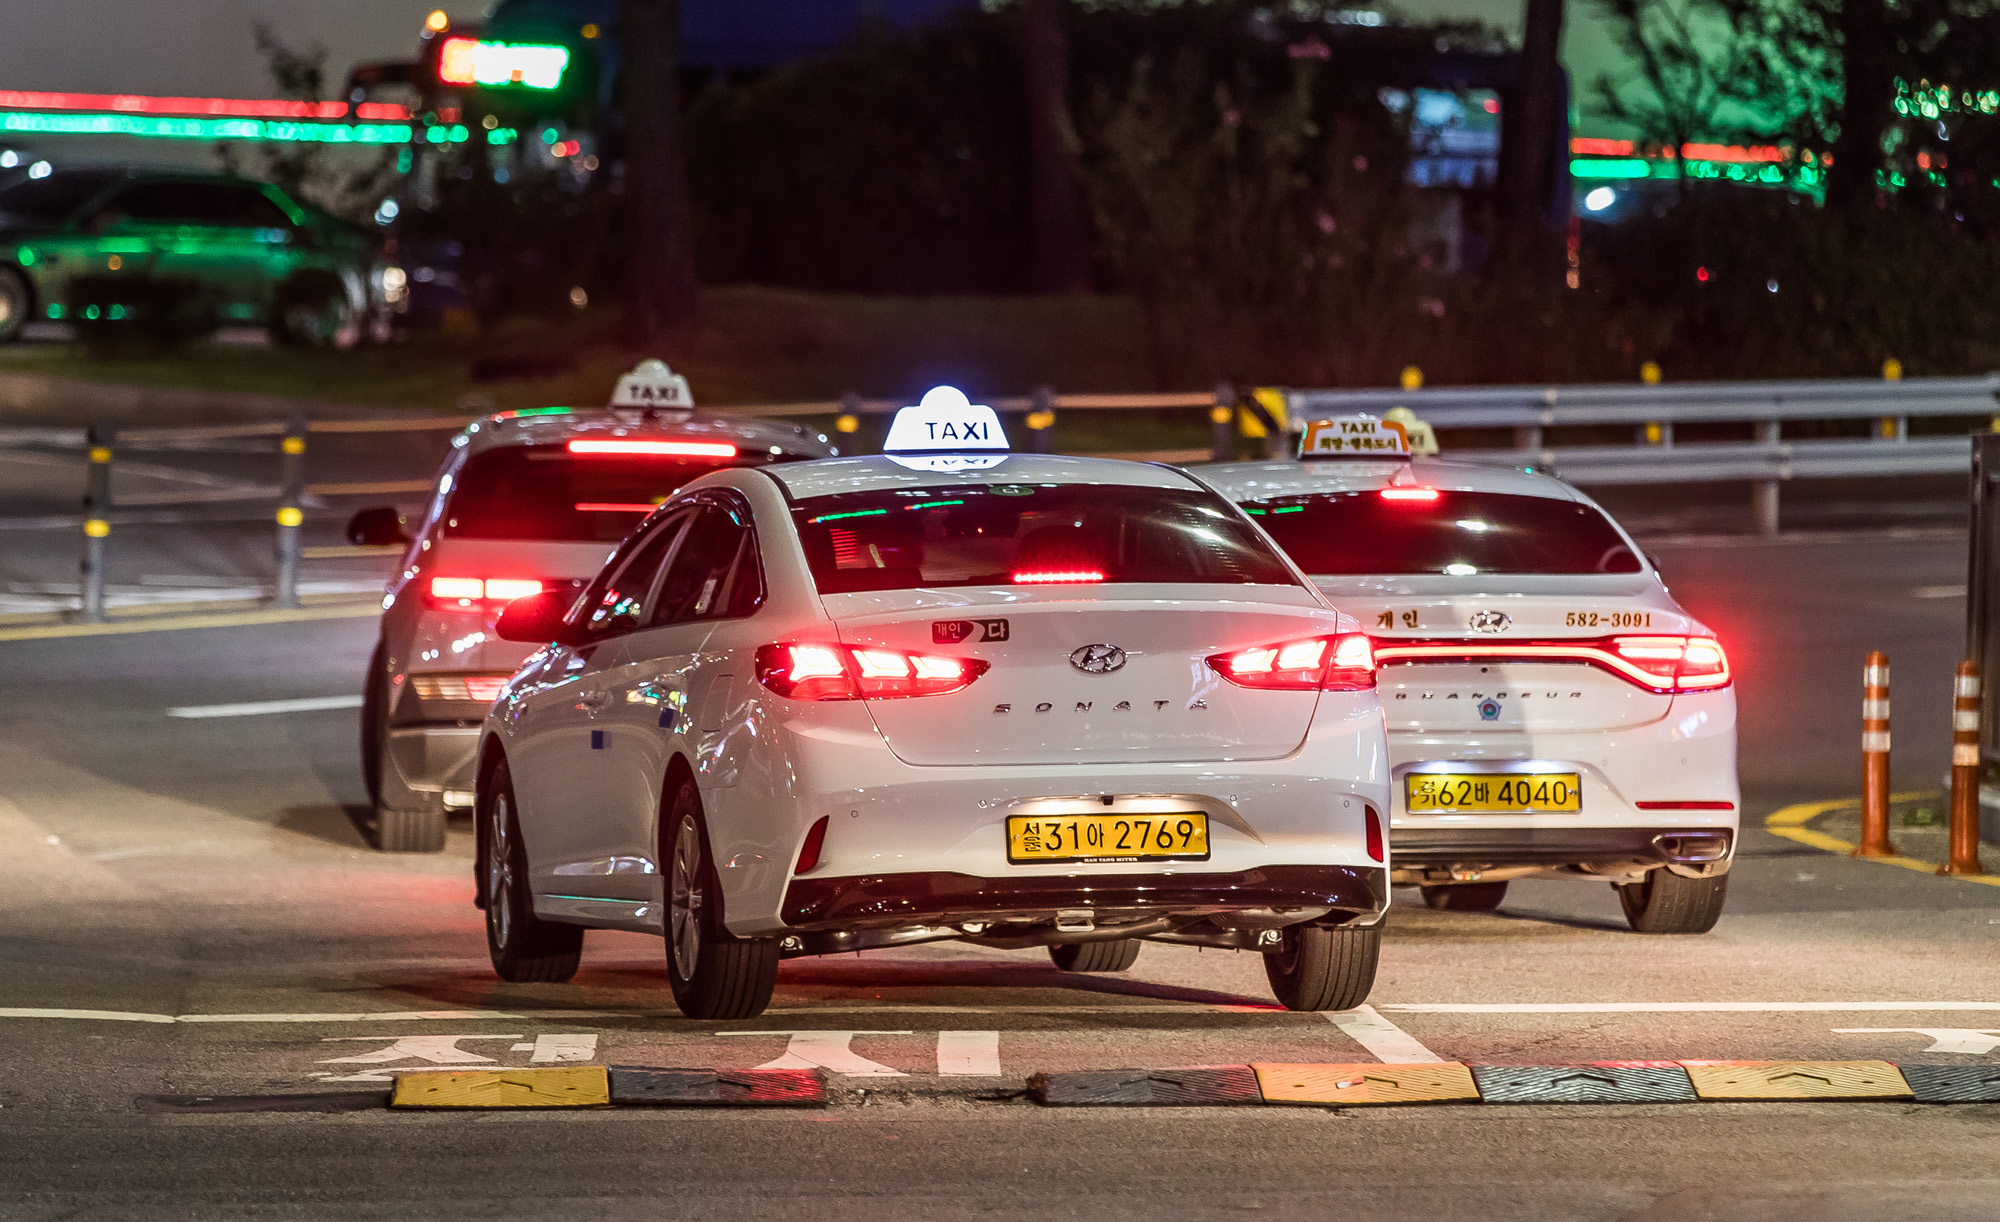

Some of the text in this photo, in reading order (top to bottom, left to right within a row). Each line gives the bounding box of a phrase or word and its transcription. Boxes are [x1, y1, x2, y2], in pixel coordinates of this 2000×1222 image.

[628, 384, 680, 401] TAXI
[925, 421, 989, 441] TAXI
[1339, 421, 1376, 434] TAXI
[1565, 611, 1652, 628] 582-3091
[935, 621, 1006, 640] 개인 다
[993, 699, 1209, 715] SONATA
[1497, 780, 1568, 806] 4040
[1114, 819, 1194, 850] 2769
